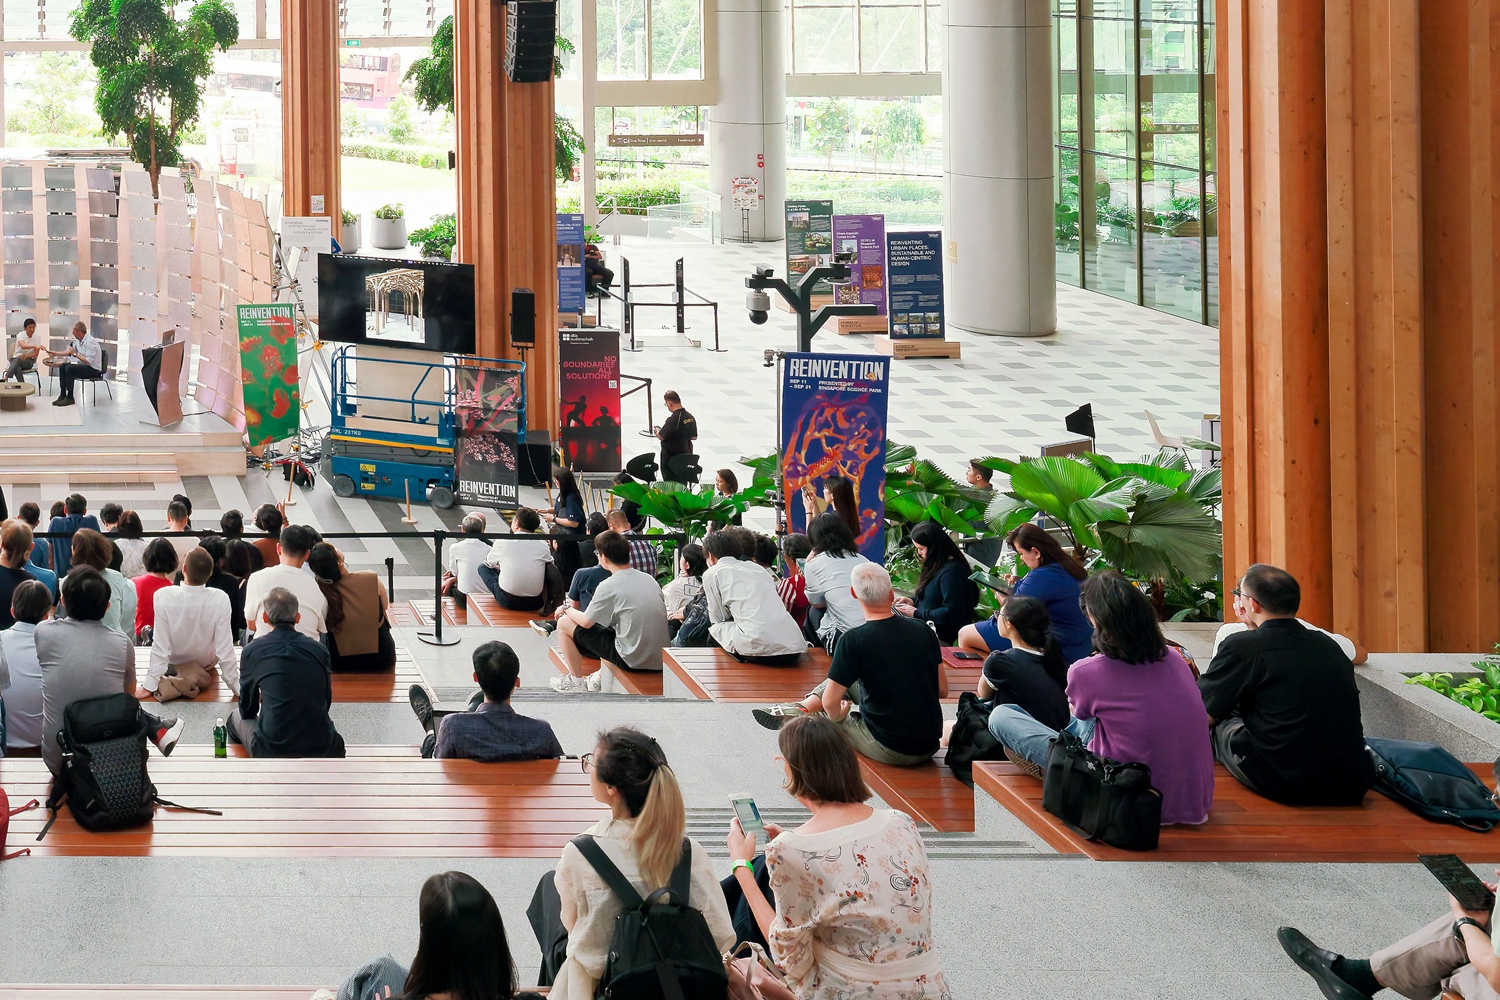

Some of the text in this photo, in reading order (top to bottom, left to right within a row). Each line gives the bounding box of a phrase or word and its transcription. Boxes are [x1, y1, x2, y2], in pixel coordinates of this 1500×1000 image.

[240, 307, 290, 319] REINVENTION
[789, 358, 884, 380] REINVENTION
[460, 480, 516, 497] REINVENTION
